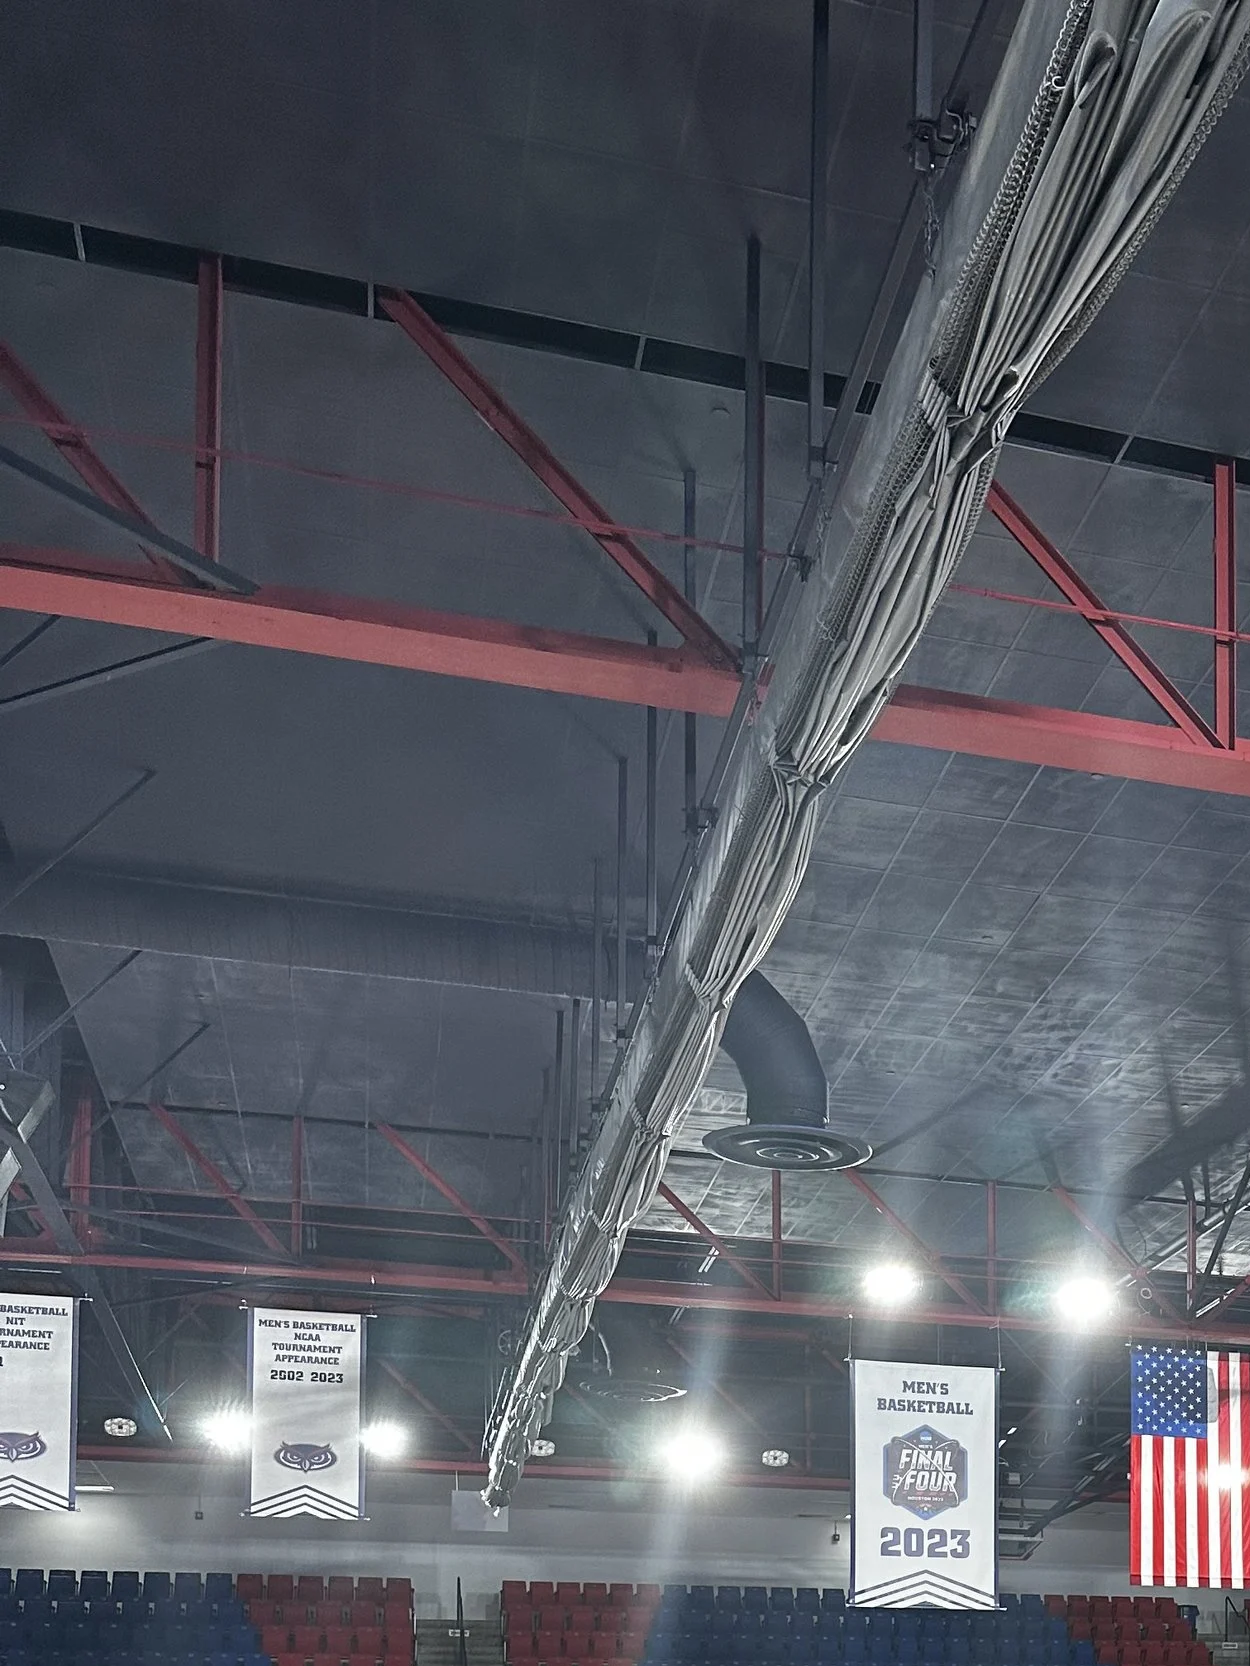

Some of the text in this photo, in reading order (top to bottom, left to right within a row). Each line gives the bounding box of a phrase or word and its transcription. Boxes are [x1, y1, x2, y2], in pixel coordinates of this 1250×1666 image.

[6, 1316, 26, 1326] NIT
[258, 1319, 356, 1333] MEN'S BASKETBALL
[293, 1332, 321, 1342] NCAA
[271, 1342, 343, 1354] TOURNAMENT
[274, 1354, 340, 1365] APPEARANCE
[310, 1372, 344, 1384] 2023
[902, 1380, 949, 1396] MEN'S
[877, 1398, 974, 1416] BASKETBALL
[899, 1448, 953, 1471] FINAL
[903, 1470, 957, 1492] FOUR
[880, 1527, 971, 1559] 2023
